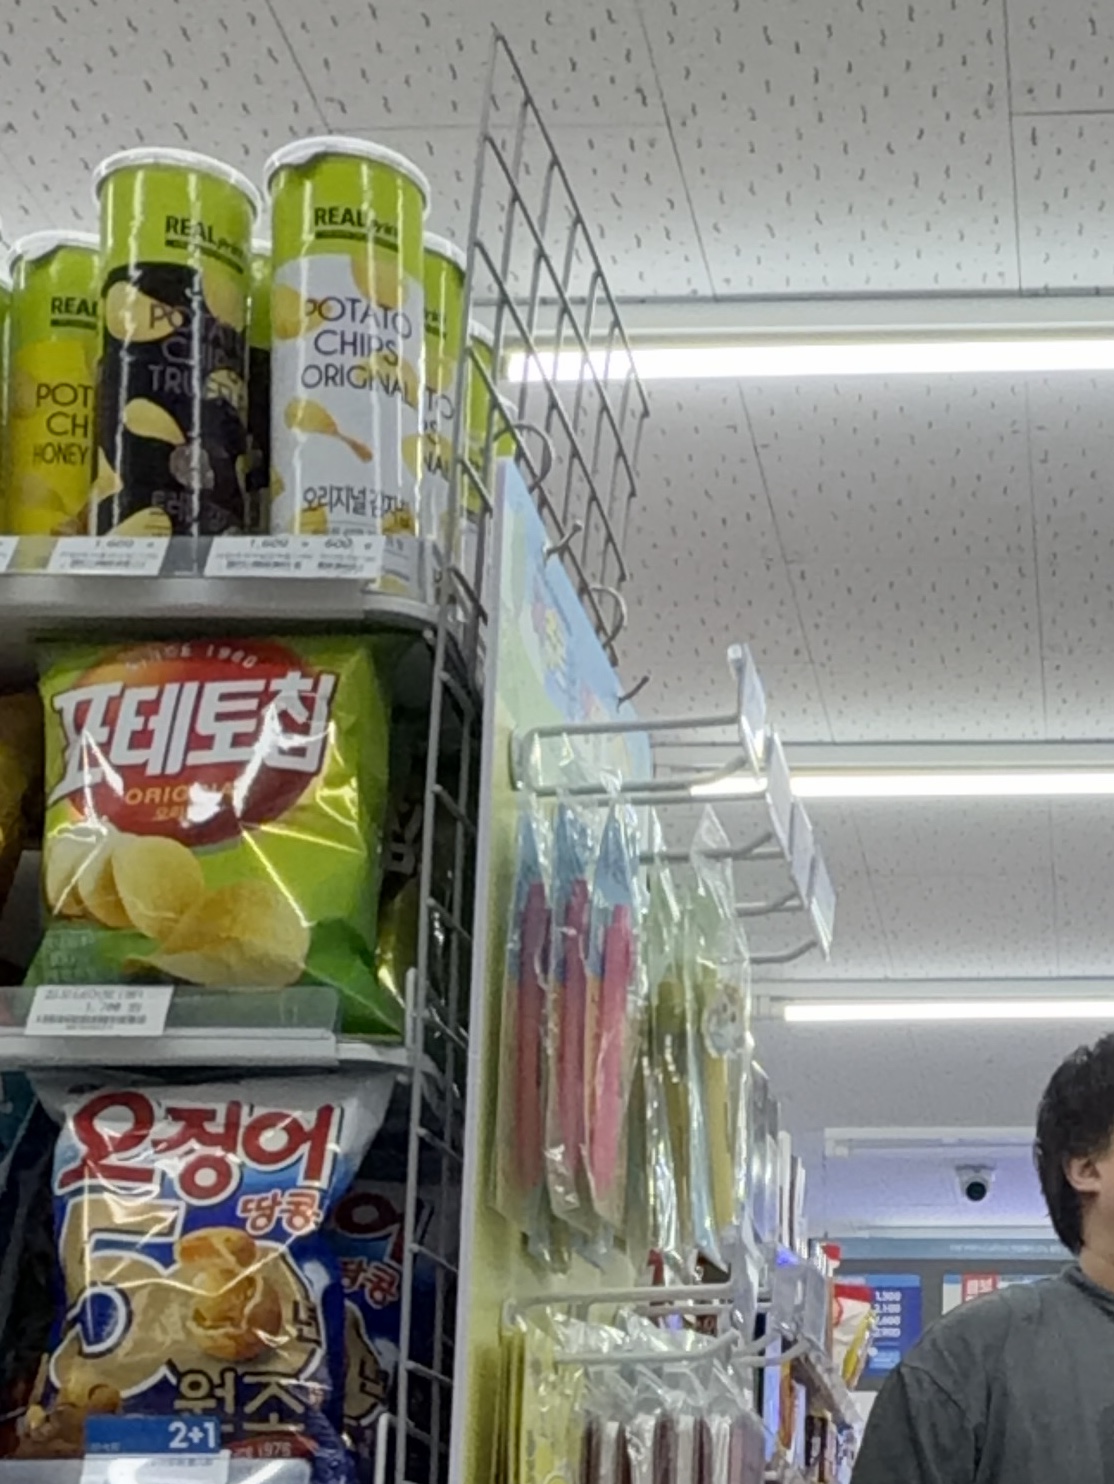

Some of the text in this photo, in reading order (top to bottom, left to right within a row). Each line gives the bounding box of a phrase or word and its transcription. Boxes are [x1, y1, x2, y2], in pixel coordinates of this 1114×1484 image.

[305, 296, 413, 340] POTATO
[314, 329, 399, 367] CHIPS
[36, 382, 94, 408] POT
[301, 363, 413, 408] ORIGINAL
[33, 442, 89, 466] HONEY
[303, 484, 367, 517] 오리지널
[47, 671, 339, 808] 포테토칩
[58, 1090, 336, 1202] 오징어
[238, 1190, 323, 1235] 땅콩
[168, 1420, 216, 1449] 2+1
